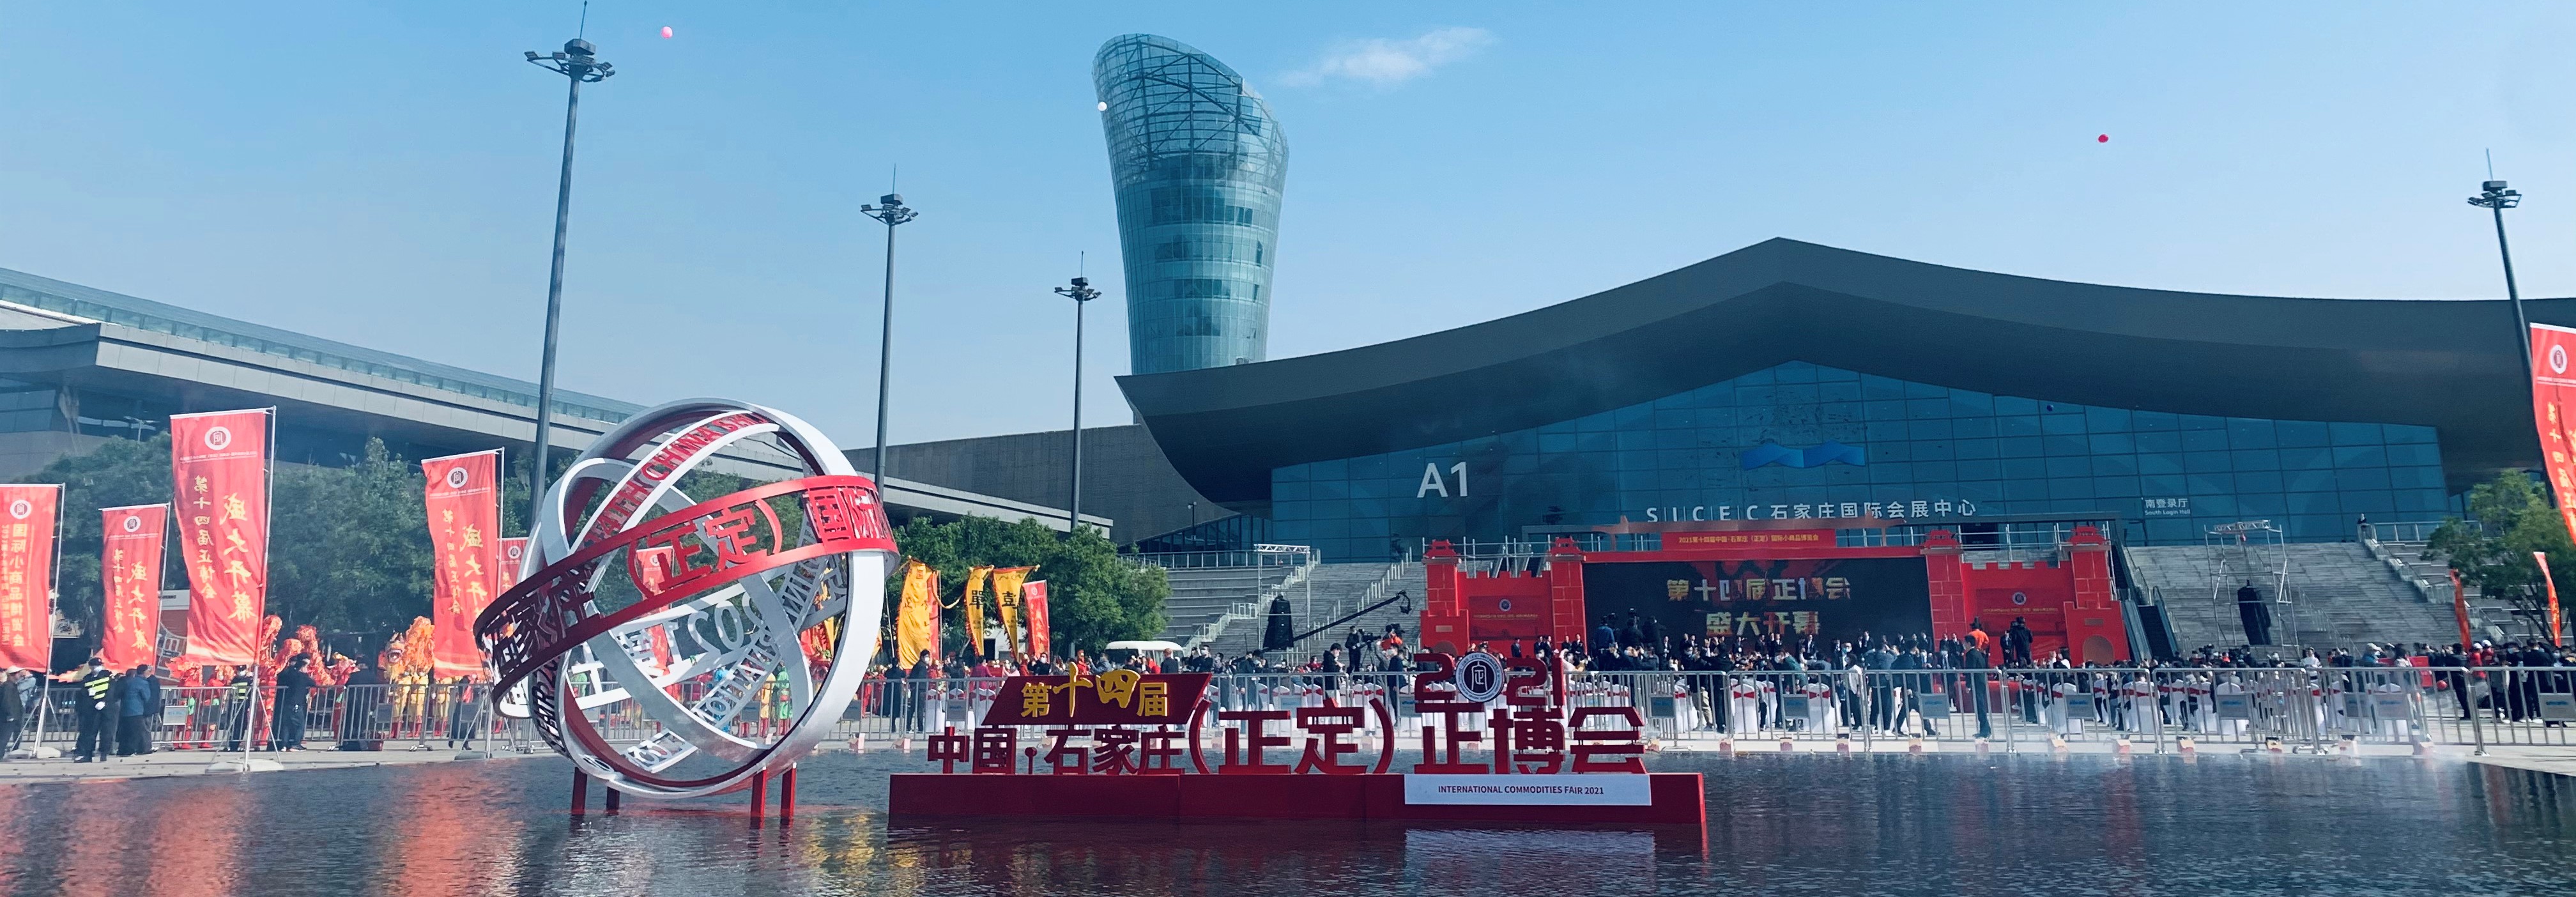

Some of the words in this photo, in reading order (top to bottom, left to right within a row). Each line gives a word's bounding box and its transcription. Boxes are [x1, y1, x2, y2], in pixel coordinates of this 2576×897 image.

[1417, 461, 1468, 498] A1
[1770, 499, 1976, 519] 石家庄国际会展中心
[1706, 611, 1821, 636] 盛大开幕
[1021, 662, 1168, 718] 第十四届
[1438, 785, 1503, 793] INTERNATIONAL
[1504, 785, 1563, 794] COMMODITIES
[1564, 786, 1583, 795] FAIR
[1584, 786, 1604, 795] 2021
